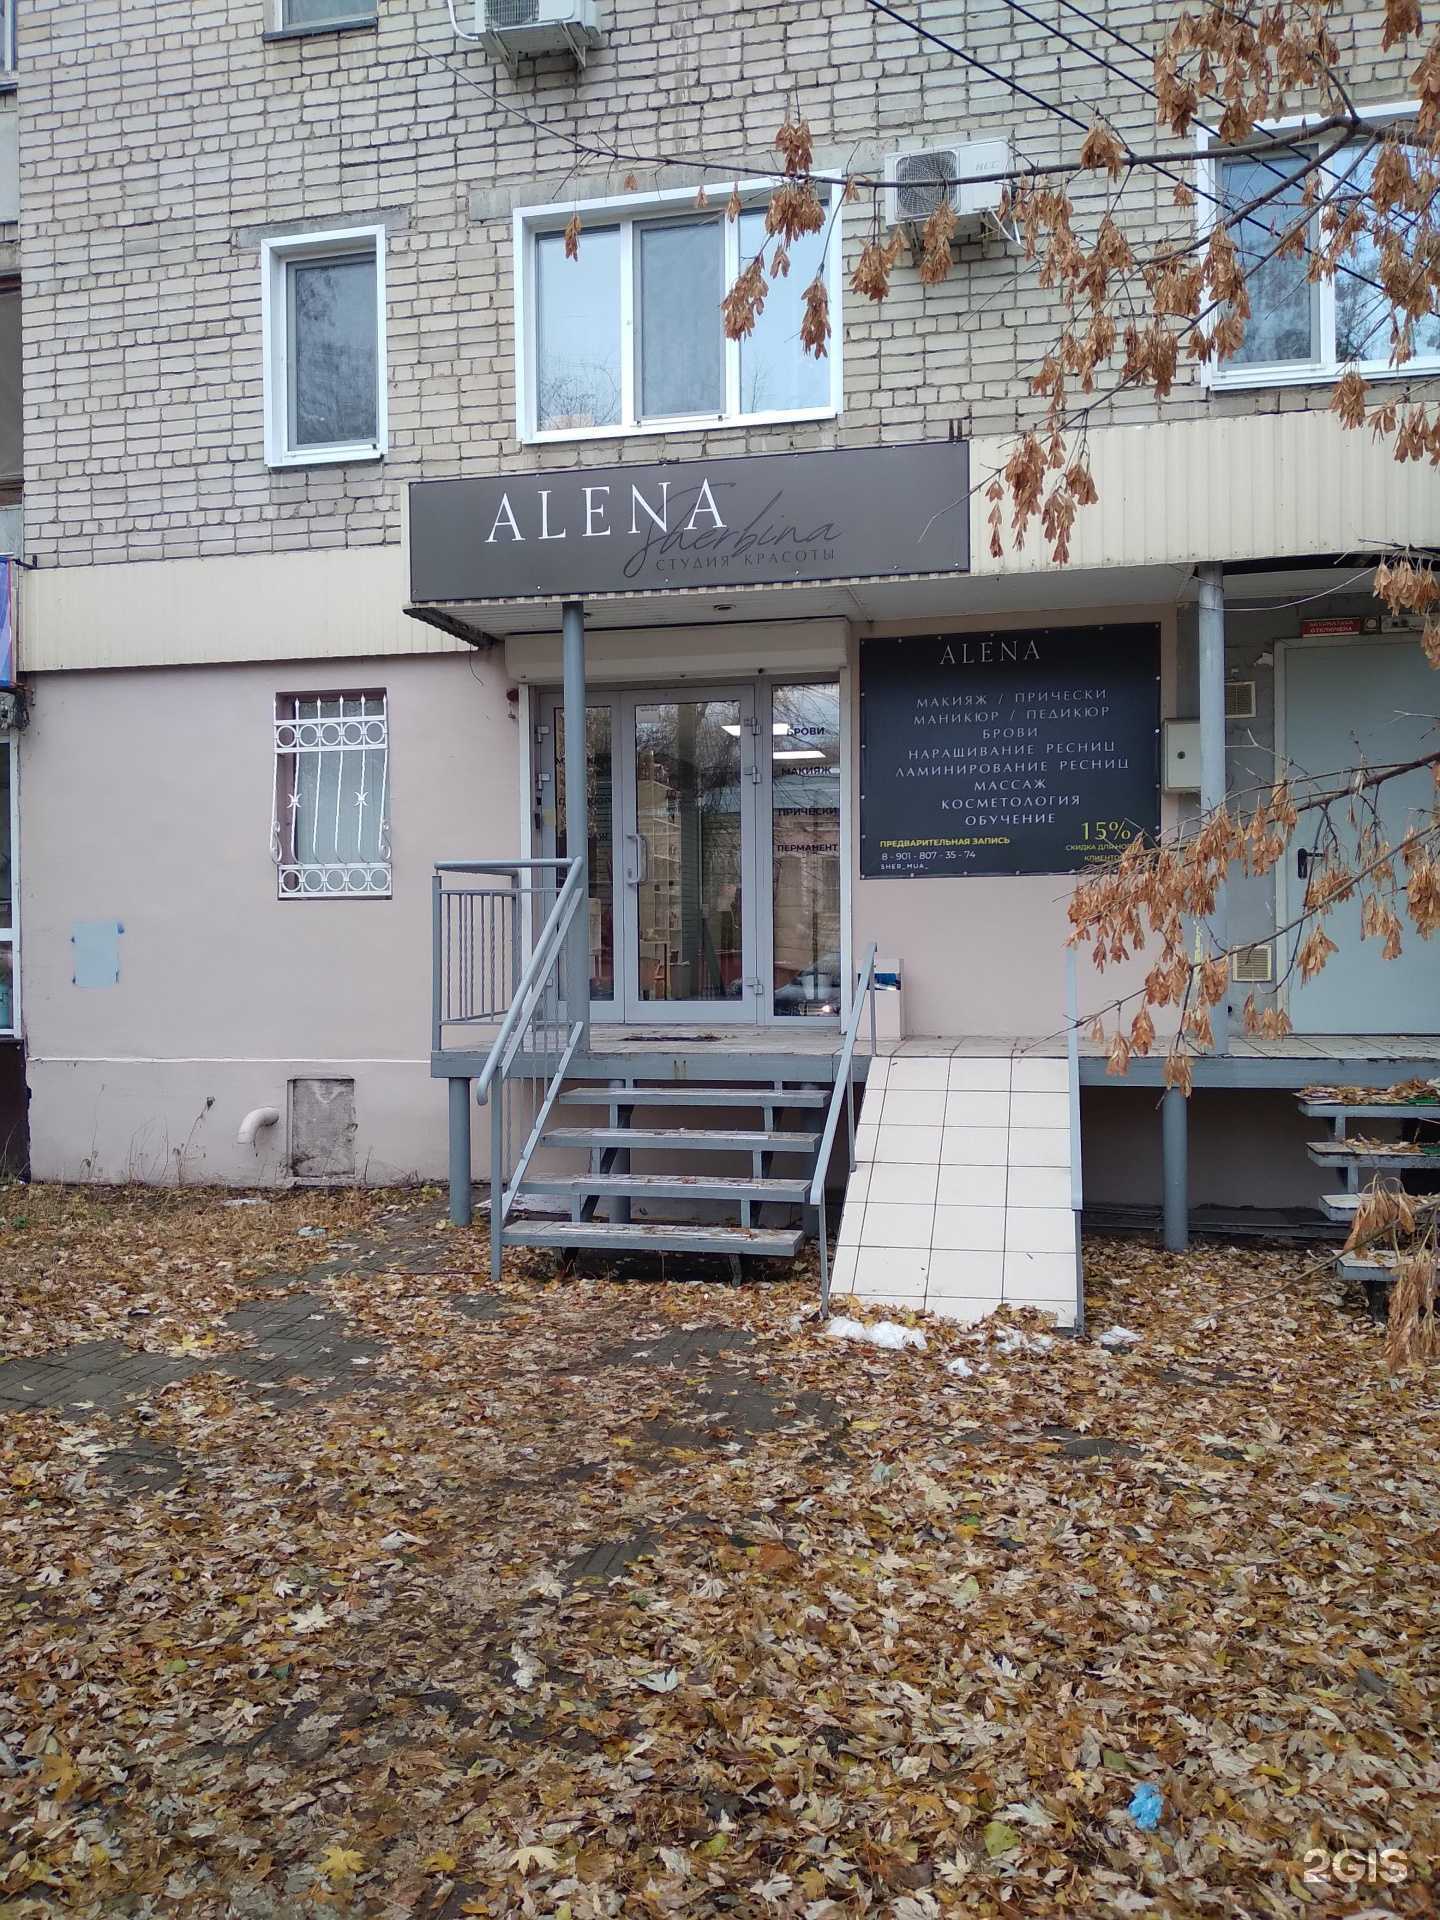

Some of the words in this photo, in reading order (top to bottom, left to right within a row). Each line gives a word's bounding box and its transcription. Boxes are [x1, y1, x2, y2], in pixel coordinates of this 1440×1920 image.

[484, 477, 728, 543] ALENA
[656, 554, 730, 572] СТУДИЯ
[744, 548, 835, 566] КРАСОТЫ
[939, 639, 1041, 665] ALENA
[916, 694, 987, 709] МАКИЯЖ
[1015, 688, 1108, 703] ПРИЧЕСКИ
[914, 711, 999, 725] МАНИКЮР
[1026, 706, 1110, 720] ПЕДИКЮР
[982, 727, 1039, 739] БРОВИ
[1046, 741, 1115, 754] РЕСНИЦ
[781, 766, 832, 776] МАКИЯЖ
[896, 761, 1048, 778] ЛАМИНИРОВАНИЕ
[1060, 758, 1129, 771] РЕСНИЦ
[974, 778, 1047, 792] МАССАЖ
[941, 795, 1081, 810] КОСМЕТОЛОГИЯ
[778, 806, 838, 817] ПРИЧЕСКИ
[965, 813, 1056, 826] ОБУЧЕНИЕ
[1081, 820, 1131, 840] 15%
[880, 838, 970, 848] ПРЕДВАРИТЕЛЬНАЯ
[972, 836, 1010, 845] ЗАПИСЬ
[1084, 854, 1122, 863] КЛИЕНТО
